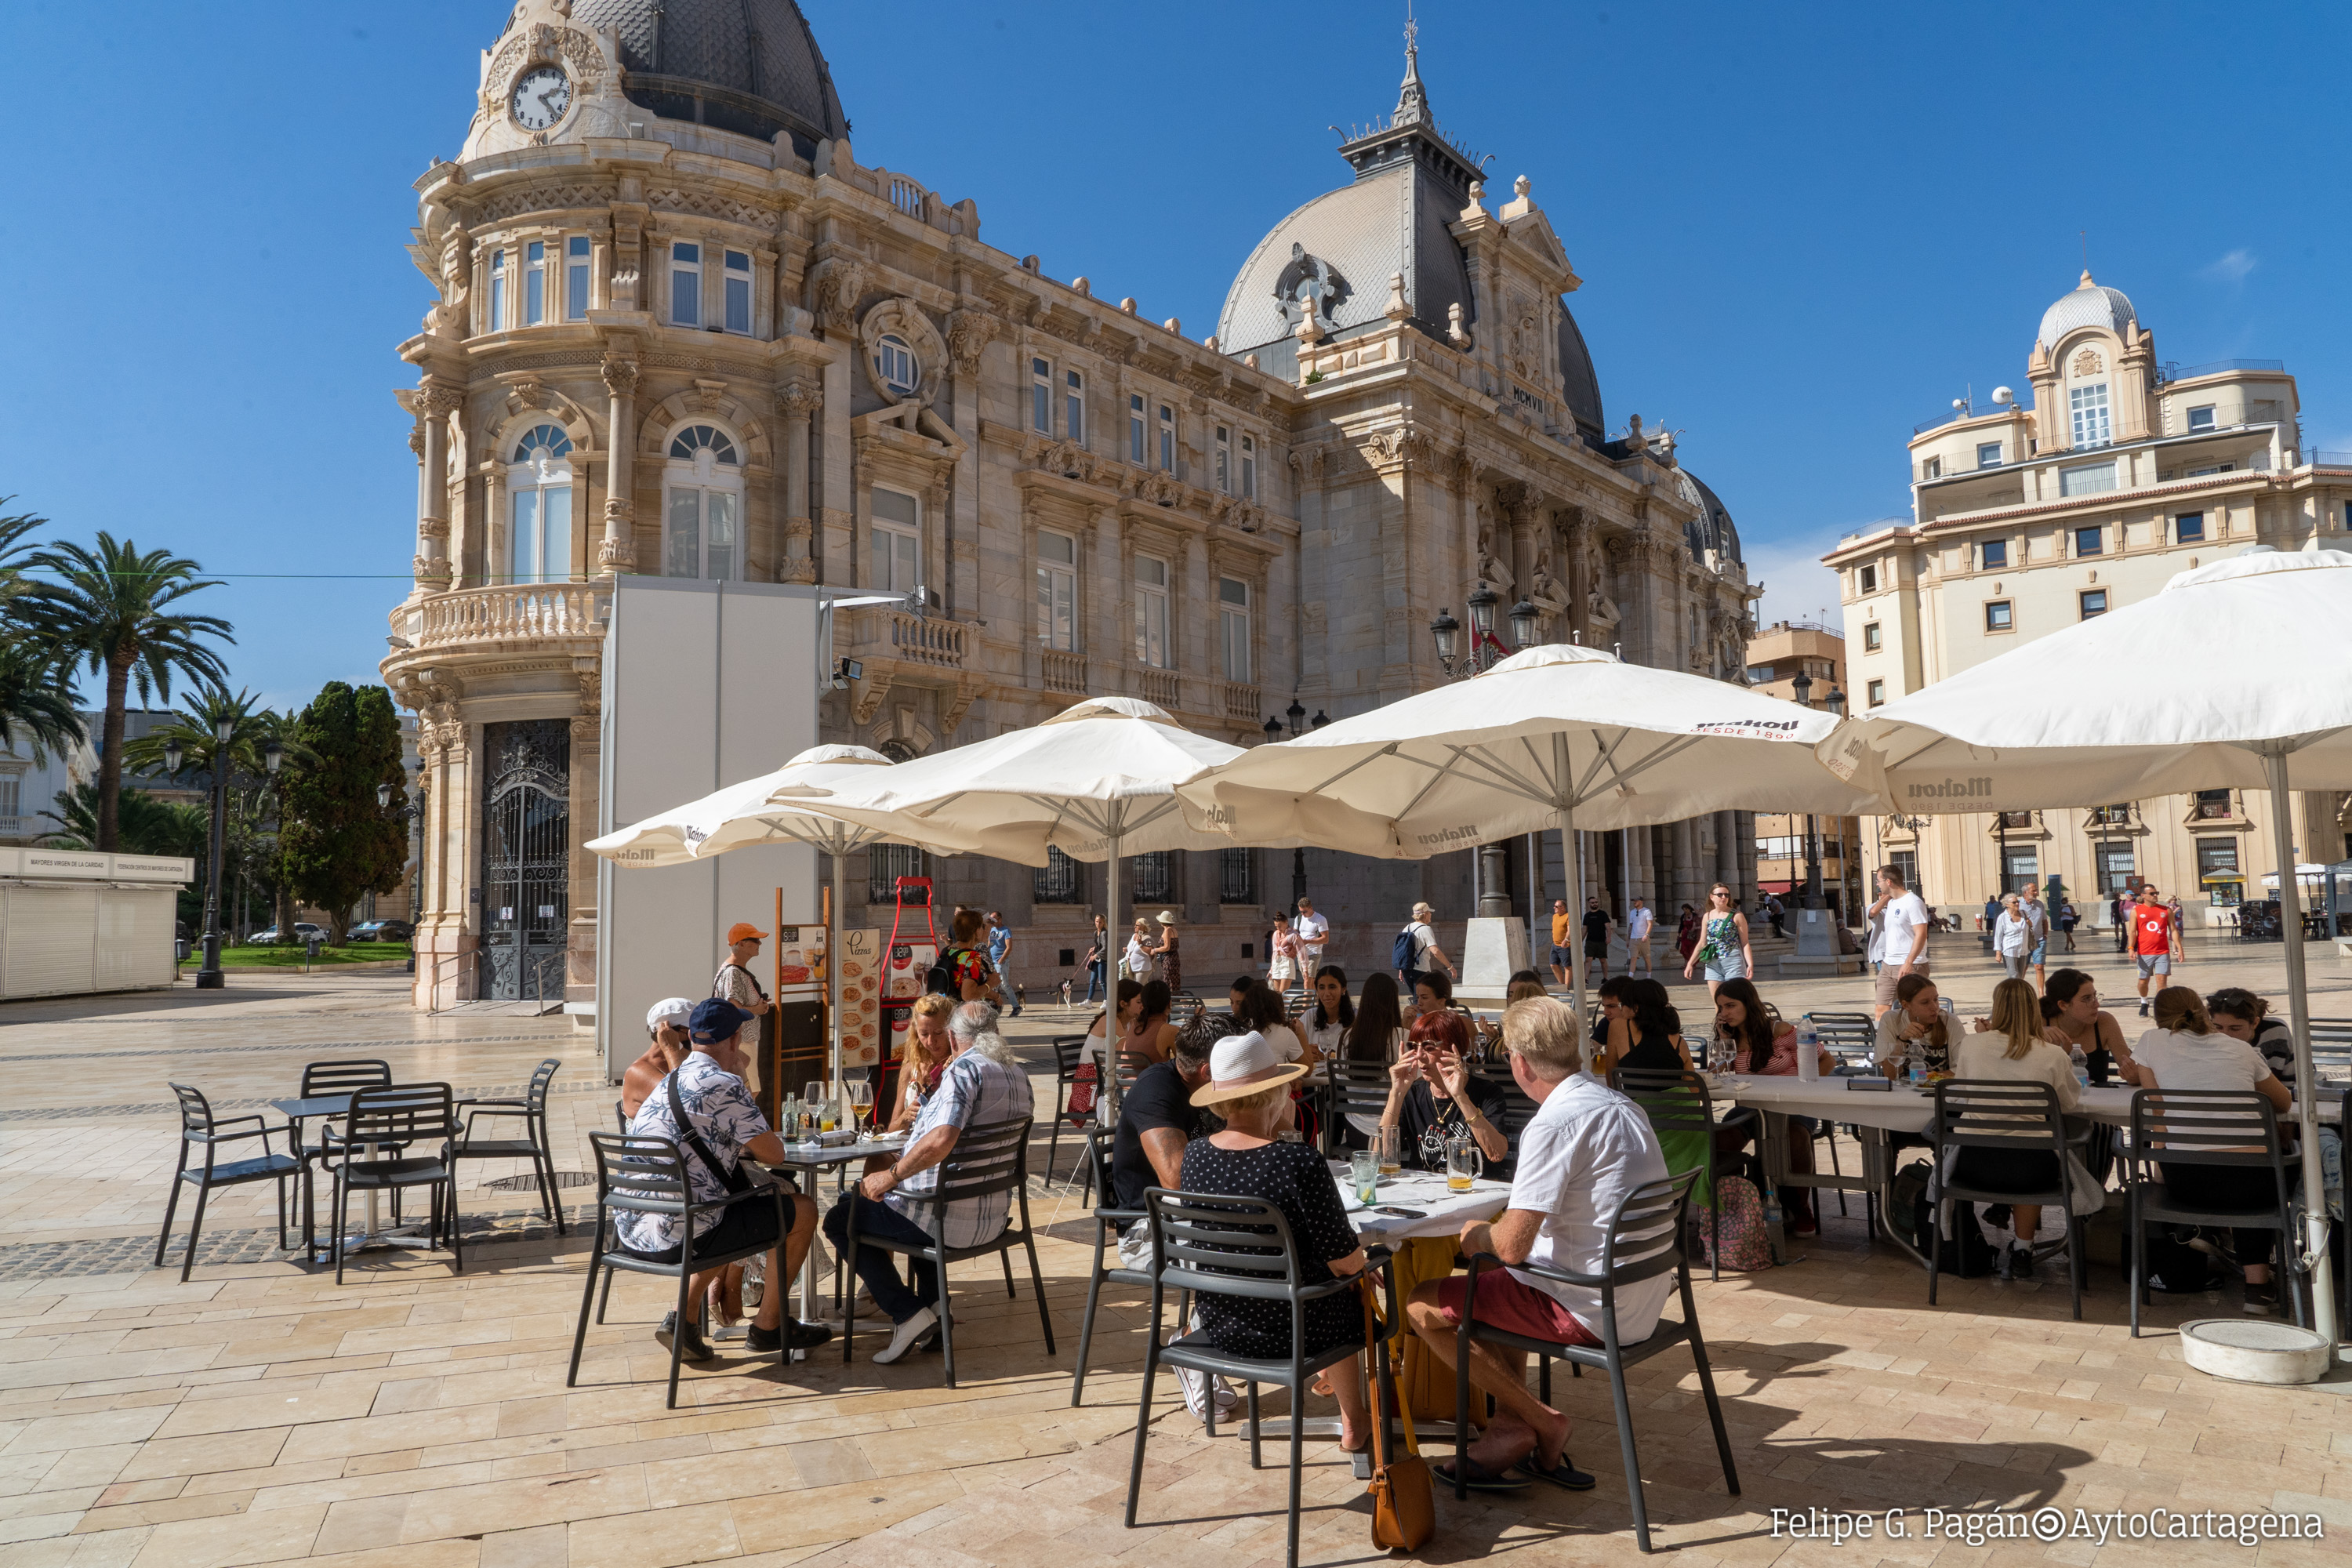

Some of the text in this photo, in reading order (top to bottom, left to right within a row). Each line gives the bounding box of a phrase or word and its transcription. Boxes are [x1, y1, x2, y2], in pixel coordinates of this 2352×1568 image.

[539, 70, 546, 78] 12
[552, 71, 556, 80] 1
[528, 76, 535, 85] 11
[559, 78, 564, 87] 2
[520, 85, 528, 94] 10
[562, 90, 568, 99] 3
[516, 99, 521, 107] 9
[557, 103, 563, 112] 4
[520, 111, 524, 120] 8
[528, 118, 533, 126] 7
[538, 118, 543, 127] 6
[1513, 385, 1543, 414] MCMVII
[1756, 730, 1794, 740] 1890
[847, 931, 872, 956] Pizzas
